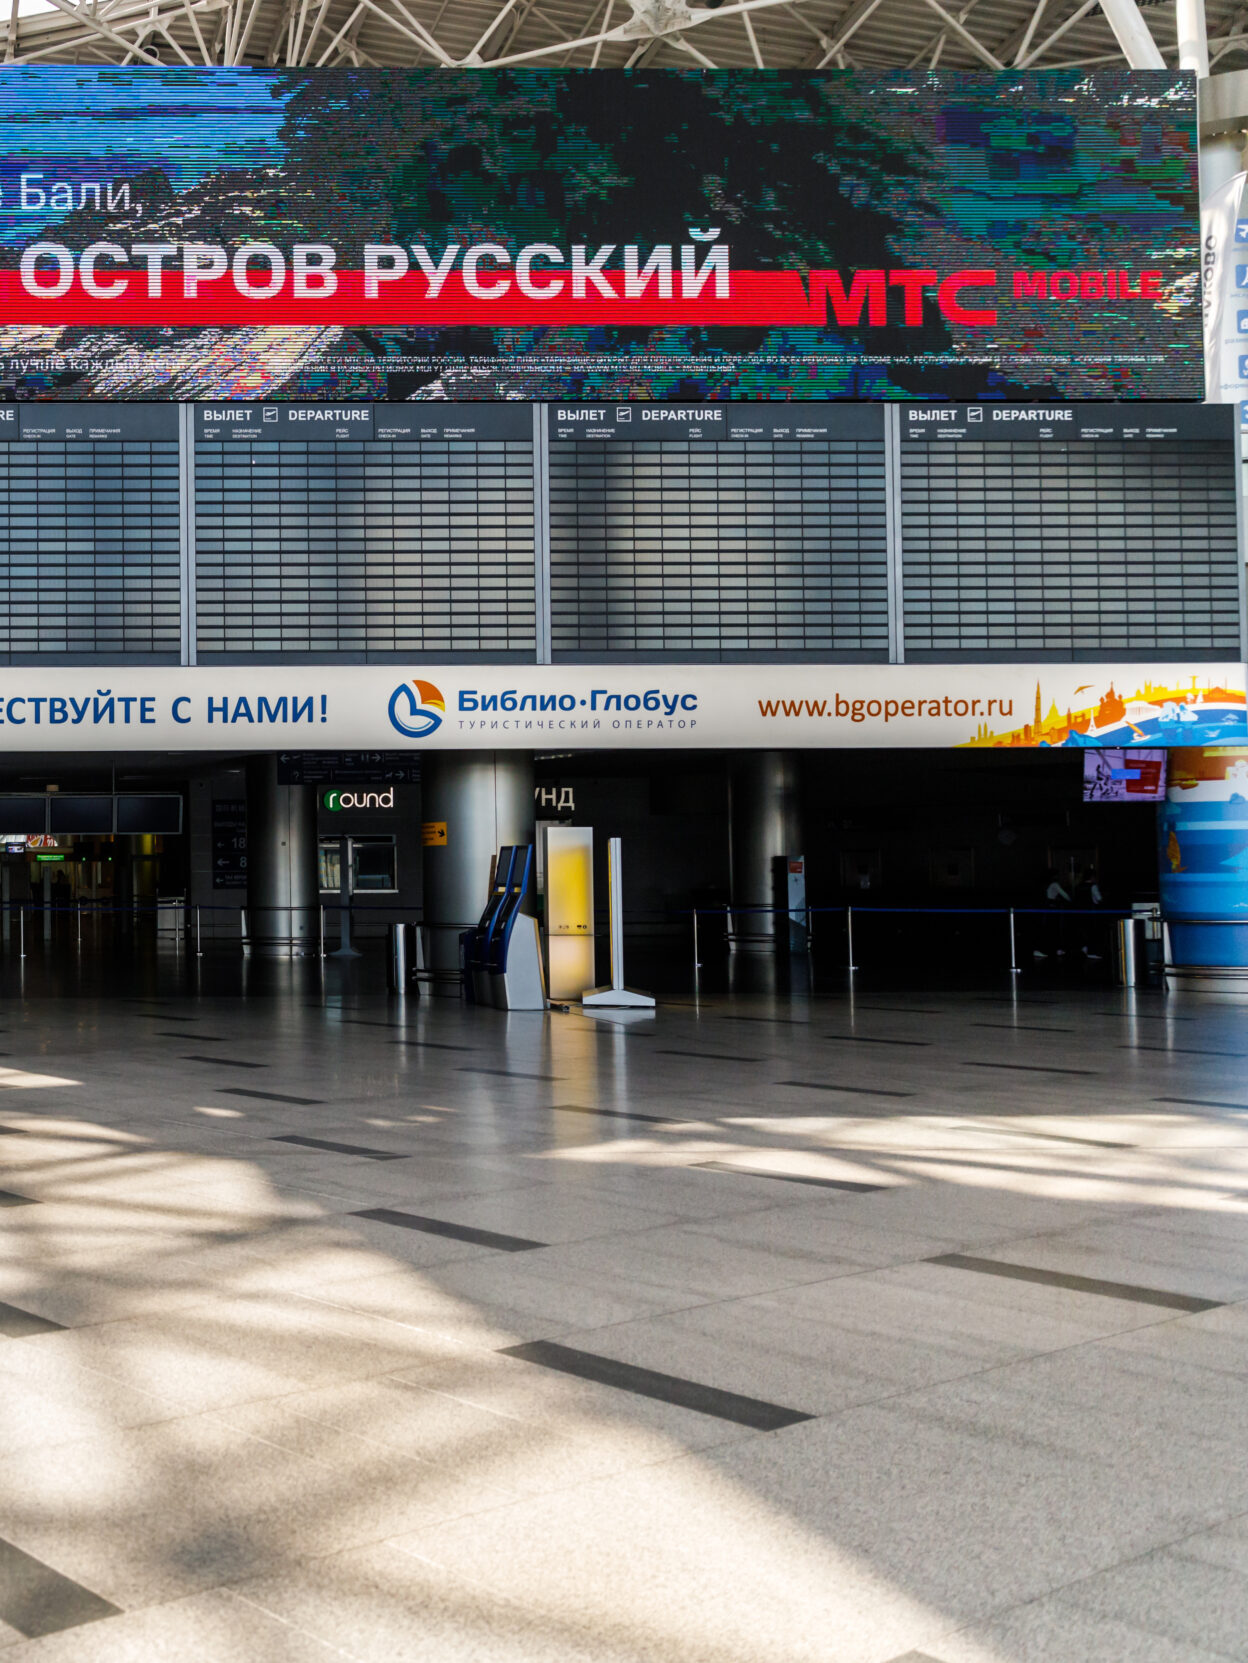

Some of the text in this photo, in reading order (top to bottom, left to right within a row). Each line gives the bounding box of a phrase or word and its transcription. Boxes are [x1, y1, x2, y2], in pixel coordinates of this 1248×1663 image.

[18, 172, 144, 218] Бали,
[19, 242, 340, 300] ОСТРОВ
[364, 228, 730, 300] РУССКИЙ
[1013, 270, 1164, 300] MOBILE
[204, 409, 252, 421] ВЫЛЕТ
[288, 409, 369, 421] DEPARTURE
[558, 409, 606, 421] ВЫЛЕТ
[642, 409, 722, 421] DEPARTURE
[909, 409, 957, 421] ВЫЛЕТ
[992, 409, 1073, 421] DEPARTURE
[172, 697, 192, 724] С
[208, 695, 328, 724] НАМИ!
[758, 693, 1013, 723] www.bgoperator.ru
[458, 719, 697, 729] ТУРИСТИЧЕСКИЙ ОПЕРАТОР
[329, 786, 394, 808] round
